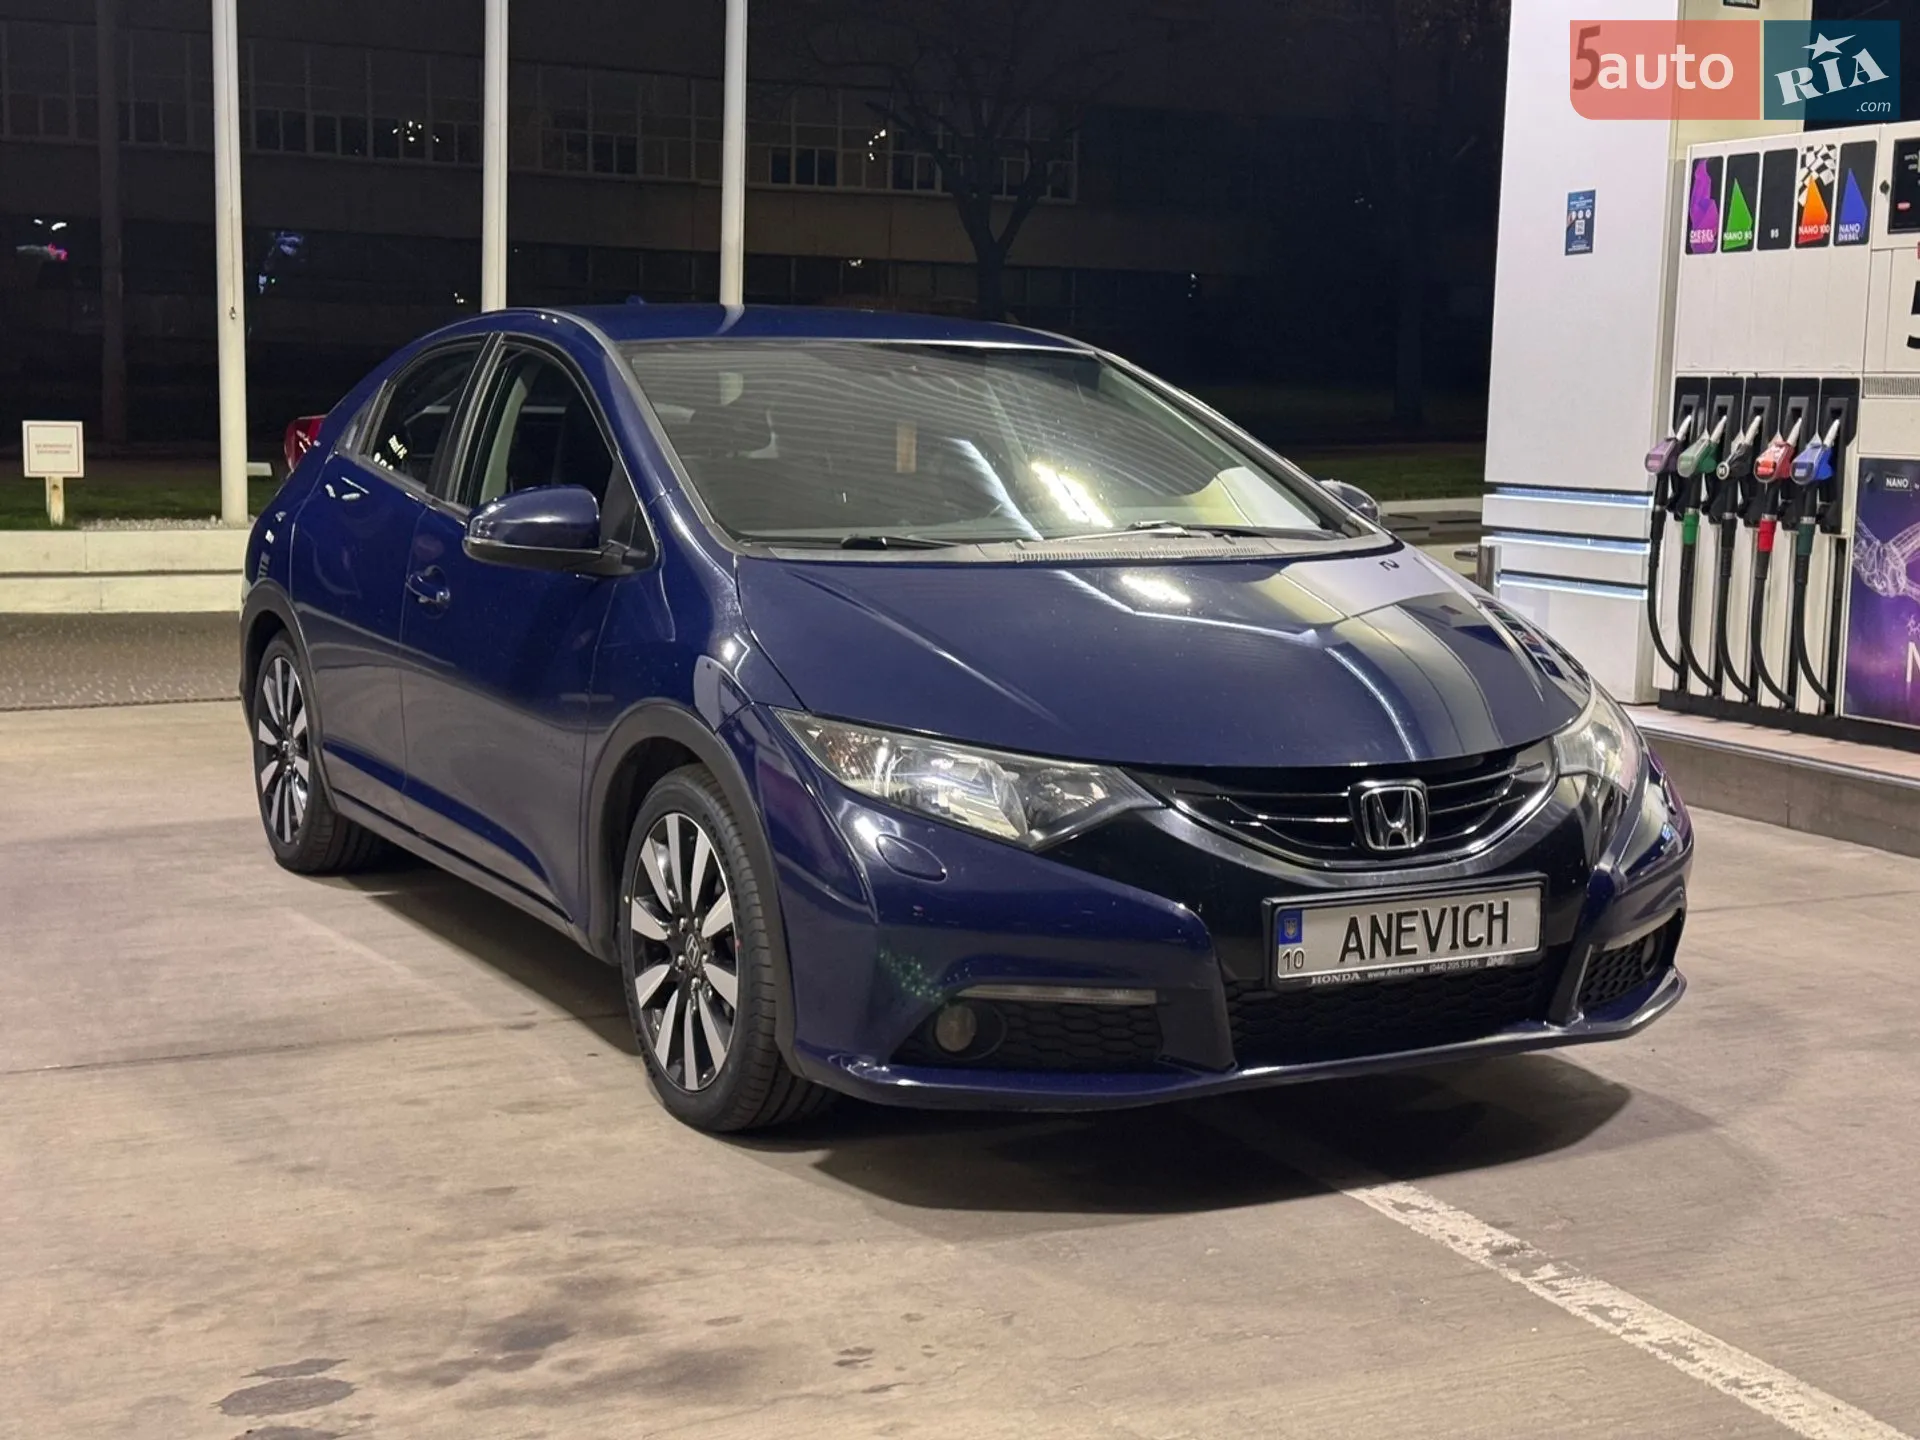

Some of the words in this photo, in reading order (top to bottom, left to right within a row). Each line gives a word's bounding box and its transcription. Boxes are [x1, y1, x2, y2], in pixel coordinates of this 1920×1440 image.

[1799, 224, 1819, 235] NANO
[1820, 224, 1831, 234] 100
[1838, 223, 1861, 233] NANO
[1723, 231, 1743, 241] NANO
[1885, 477, 1909, 489] NANO
[1338, 900, 1509, 963] ANEVICH
[1281, 949, 1305, 970] 10
[1311, 972, 1361, 985] HONDA
